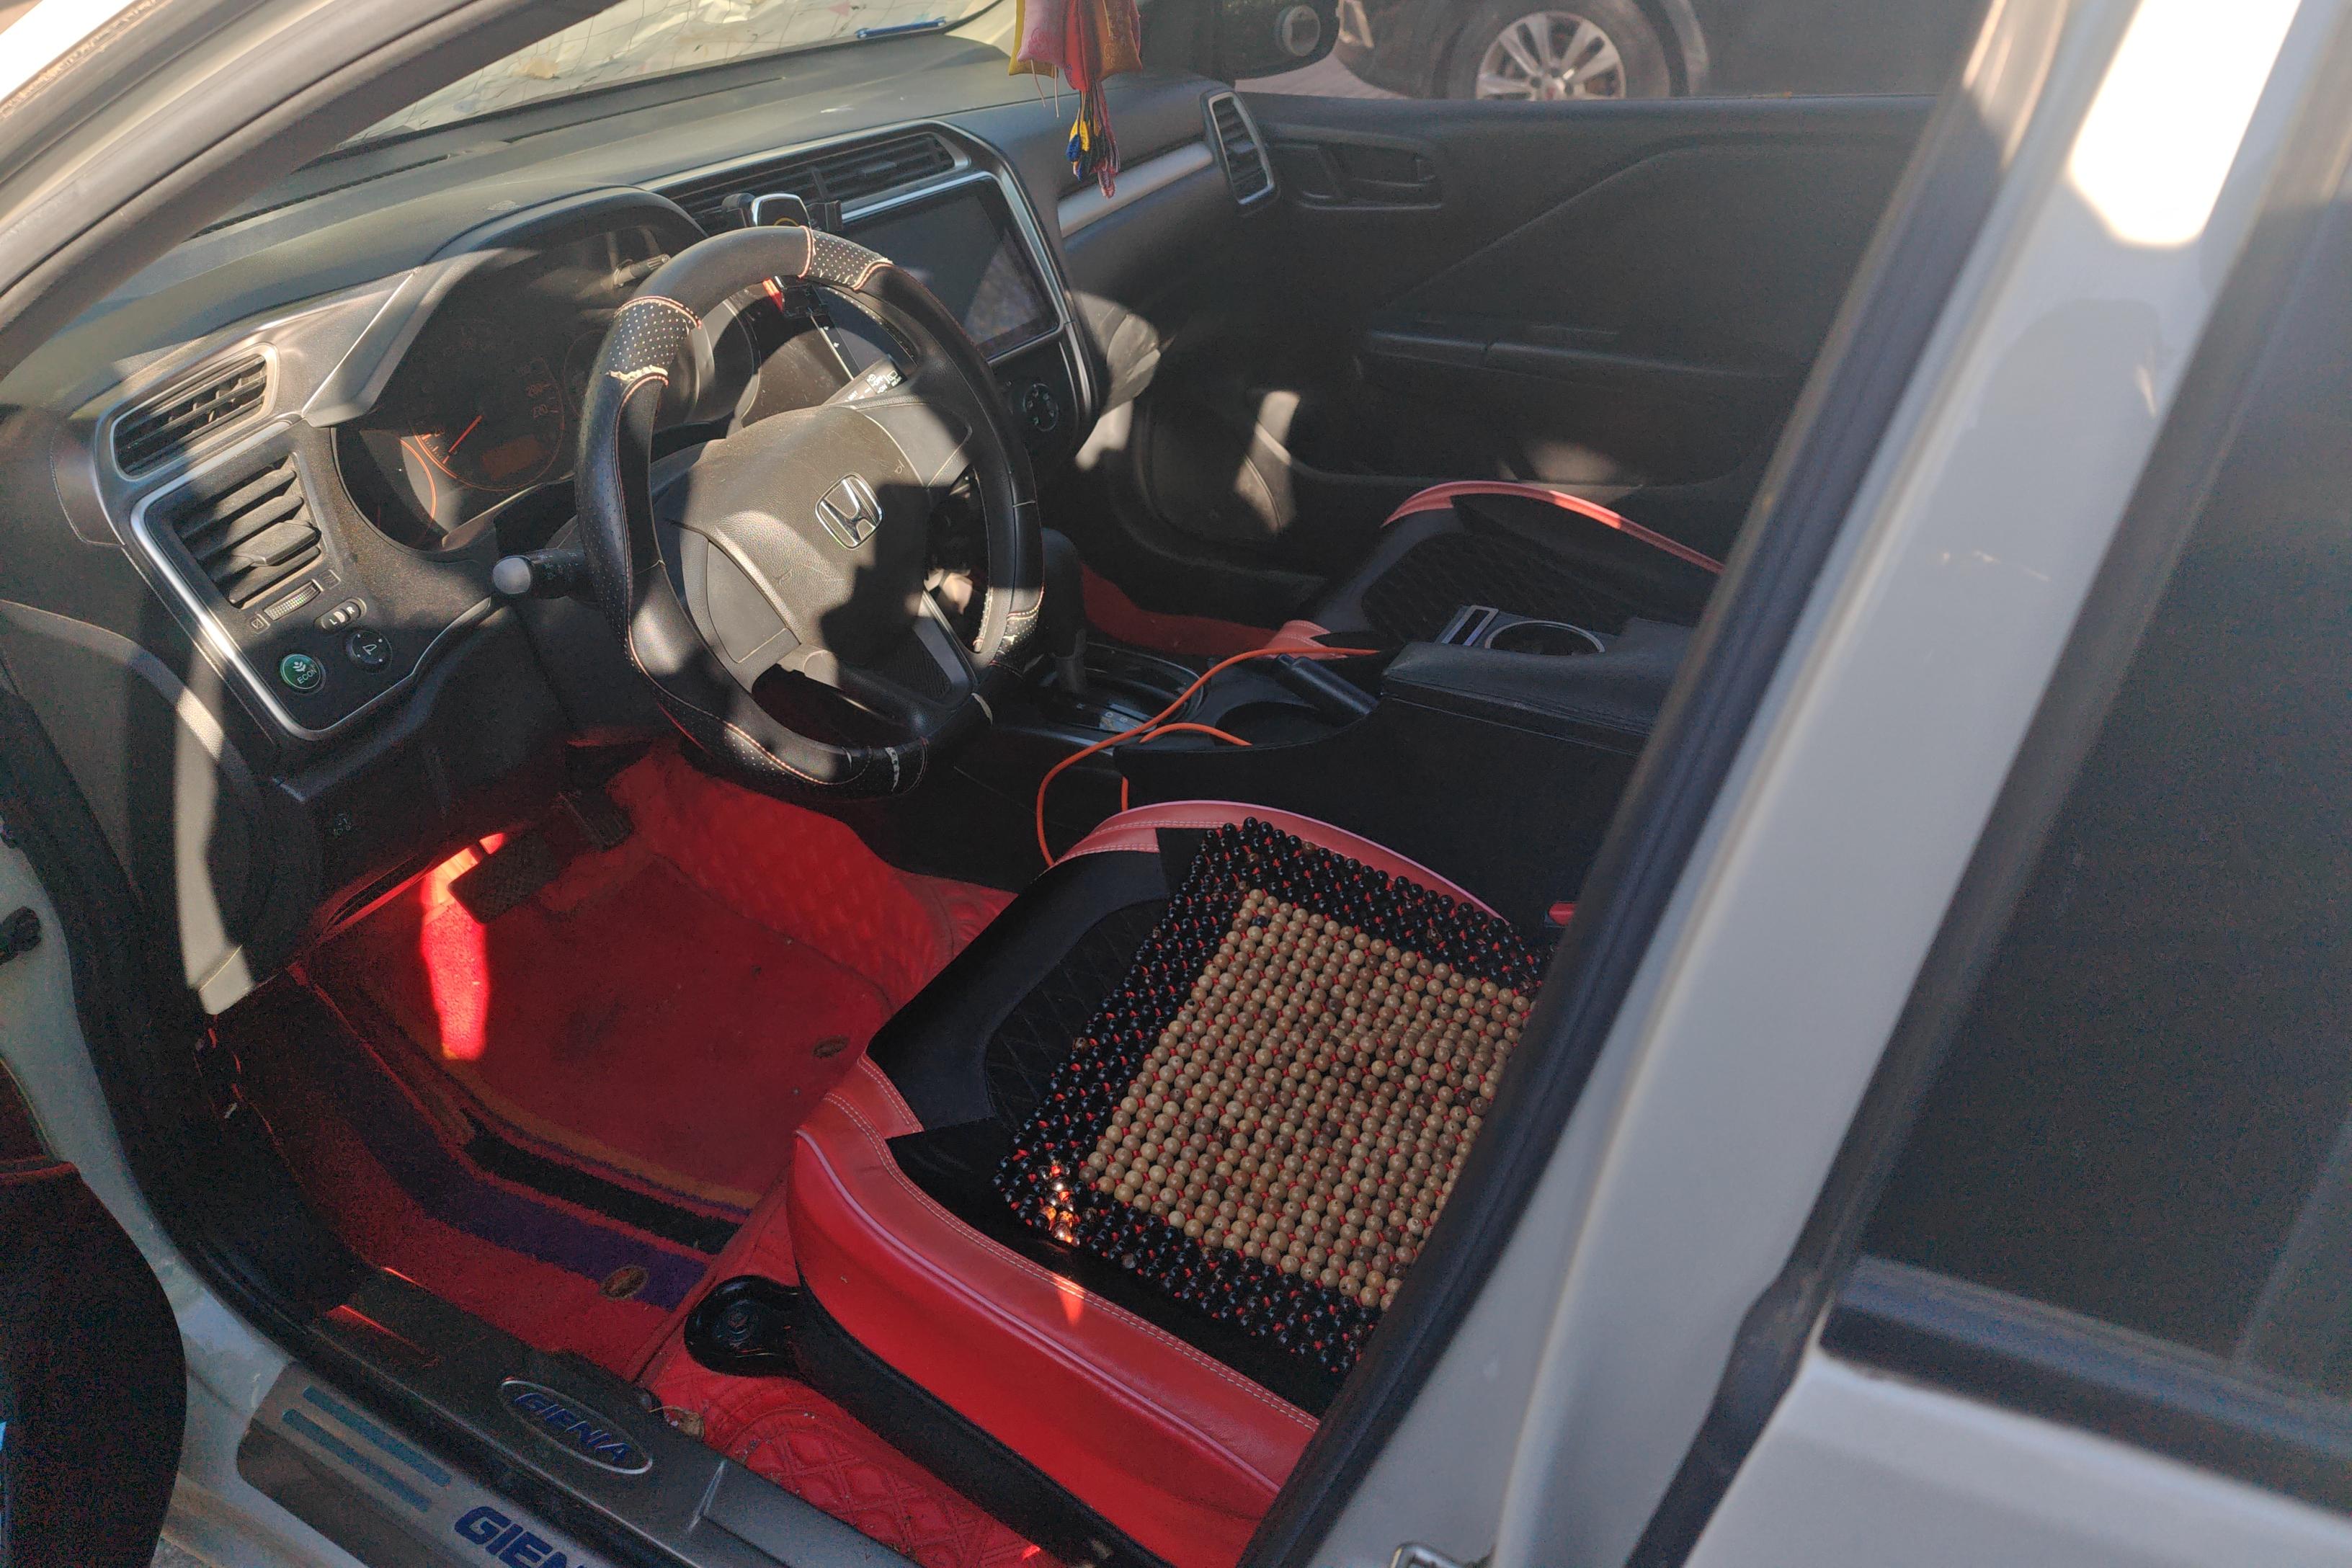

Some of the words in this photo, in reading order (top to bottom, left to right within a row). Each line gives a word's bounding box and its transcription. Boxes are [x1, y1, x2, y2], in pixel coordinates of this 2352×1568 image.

[346, 606, 355, 615] R
[297, 667, 317, 685] ECON
[514, 1392, 632, 1464] GIENIA
